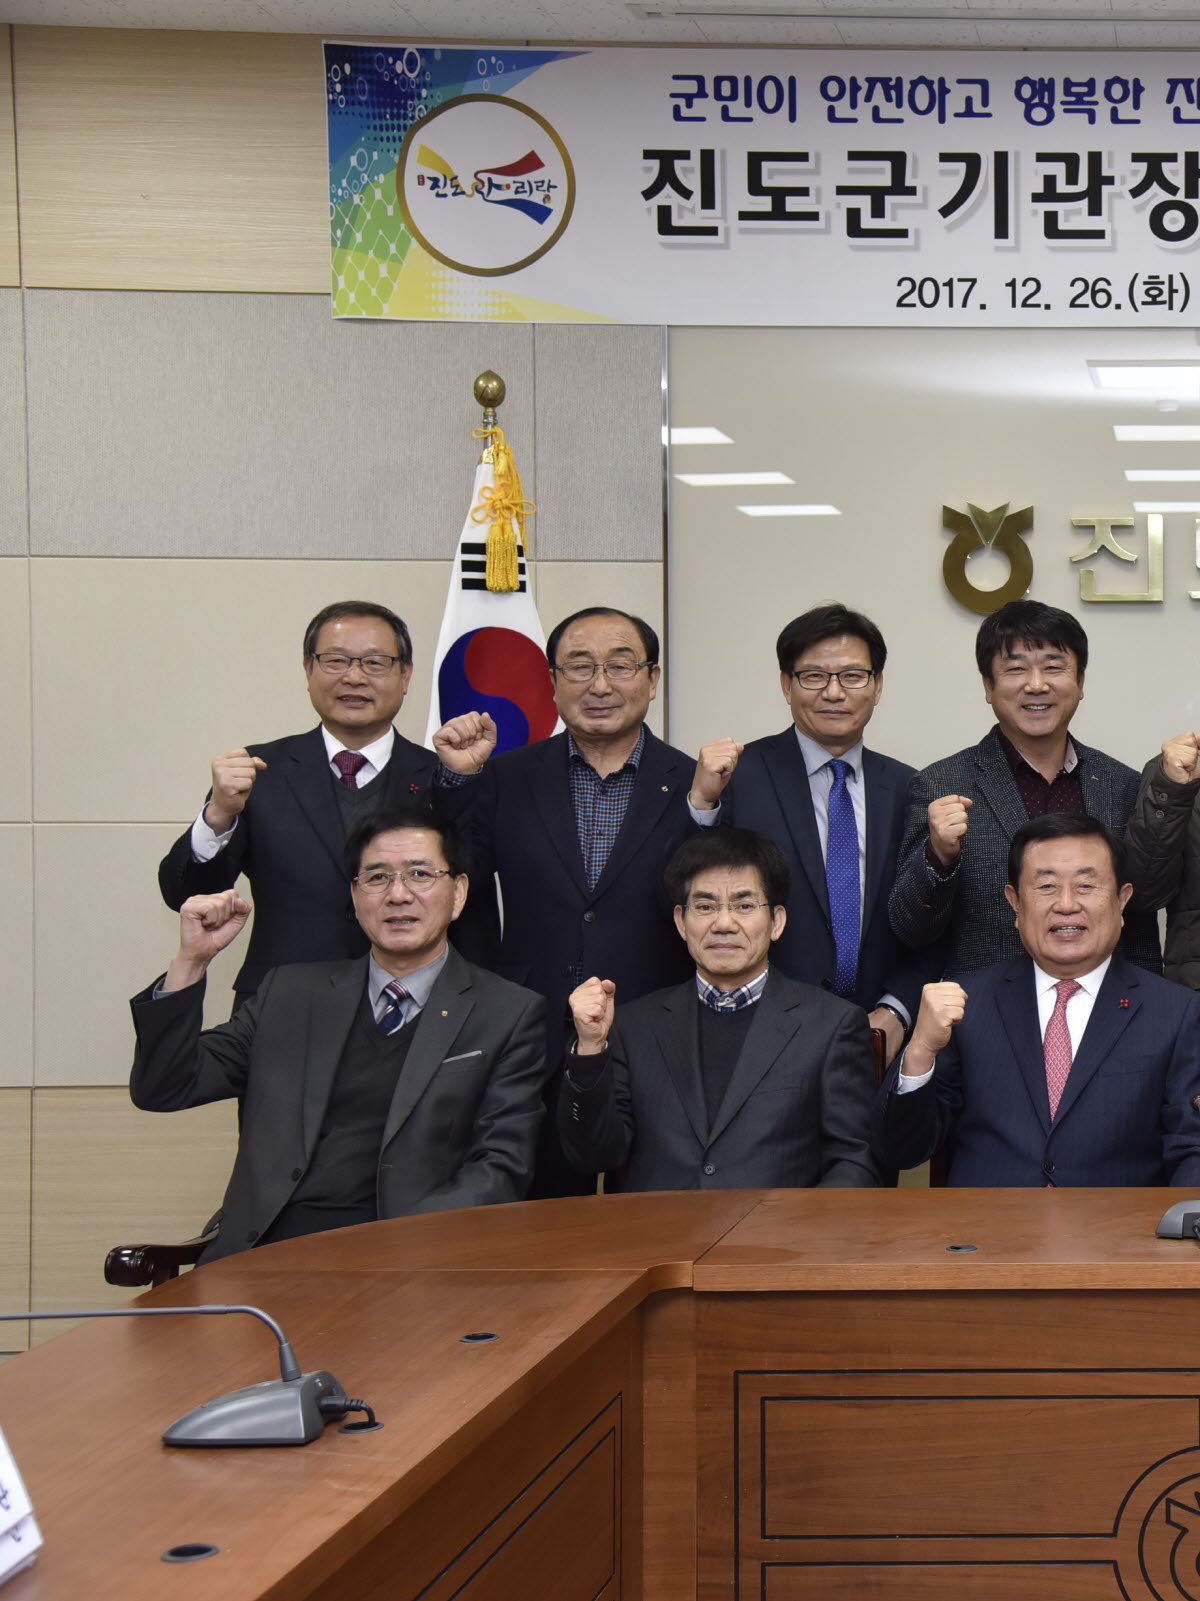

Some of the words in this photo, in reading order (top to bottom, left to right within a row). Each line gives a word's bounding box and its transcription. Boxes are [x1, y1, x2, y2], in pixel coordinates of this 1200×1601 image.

[669, 74, 798, 125] 군민이
[820, 75, 994, 126] 안전하고
[1014, 76, 1147, 127] 행복한
[896, 276, 988, 311] 2017.
[1005, 277, 1052, 311] 12.
[1069, 272, 1192, 313] 26.(화)
